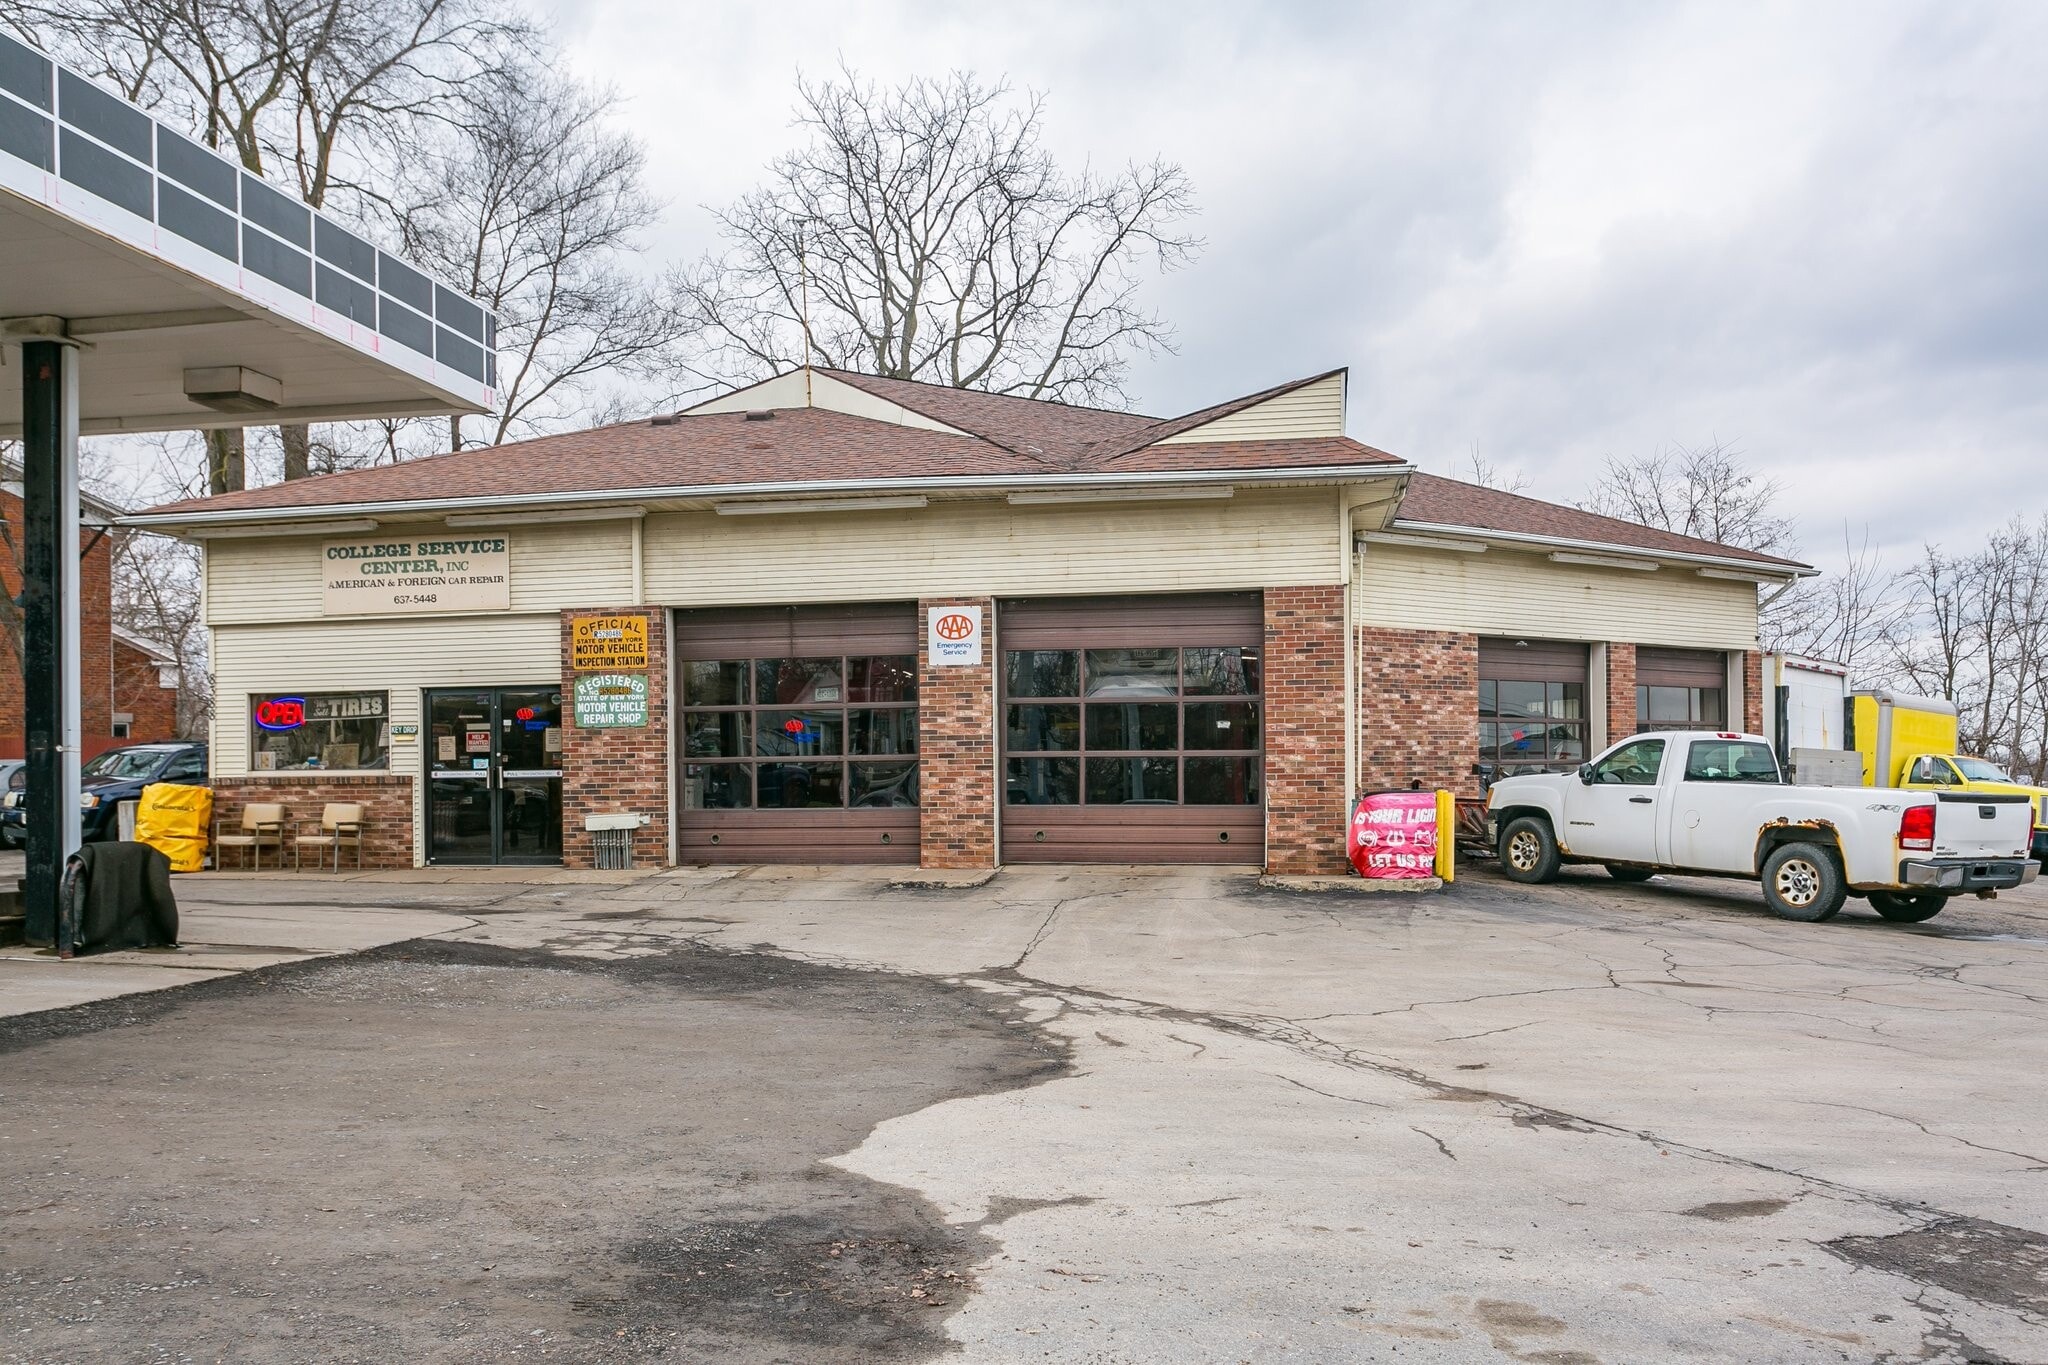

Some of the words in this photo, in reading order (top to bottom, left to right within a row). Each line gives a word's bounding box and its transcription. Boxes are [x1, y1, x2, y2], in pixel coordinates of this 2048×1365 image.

[327, 543, 411, 559] COLLEGE
[417, 539, 505, 556] SERVICE
[360, 559, 444, 575] CENTER,
[446, 561, 470, 572] INC
[328, 579, 385, 589] AMERICAN
[397, 577, 446, 587] FOREIGN
[448, 576, 467, 585] CAR
[469, 575, 504, 584] REPAIR
[394, 594, 437, 604] 637-5448
[579, 619, 641, 635] OFFICIAL
[938, 615, 971, 639] AAA
[576, 645, 604, 654] MOTOR
[607, 643, 644, 653] VEHICLE
[575, 657, 615, 667] INSPECTION
[617, 655, 645, 666] STATION
[577, 675, 645, 694] REGISTERED
[257, 701, 306, 726] OPEN
[328, 697, 383, 717] TIRES
[577, 702, 607, 713] MOTOR
[609, 701, 646, 712] VEHICLE
[583, 714, 615, 724] REPAIR
[617, 713, 642, 723] SHOP
[391, 726, 402, 734] KEY
[402, 725, 418, 734] DROP
[1368, 808, 1404, 824] YOUR
[1368, 853, 1393, 868] LET
[1396, 853, 1417, 868] US
